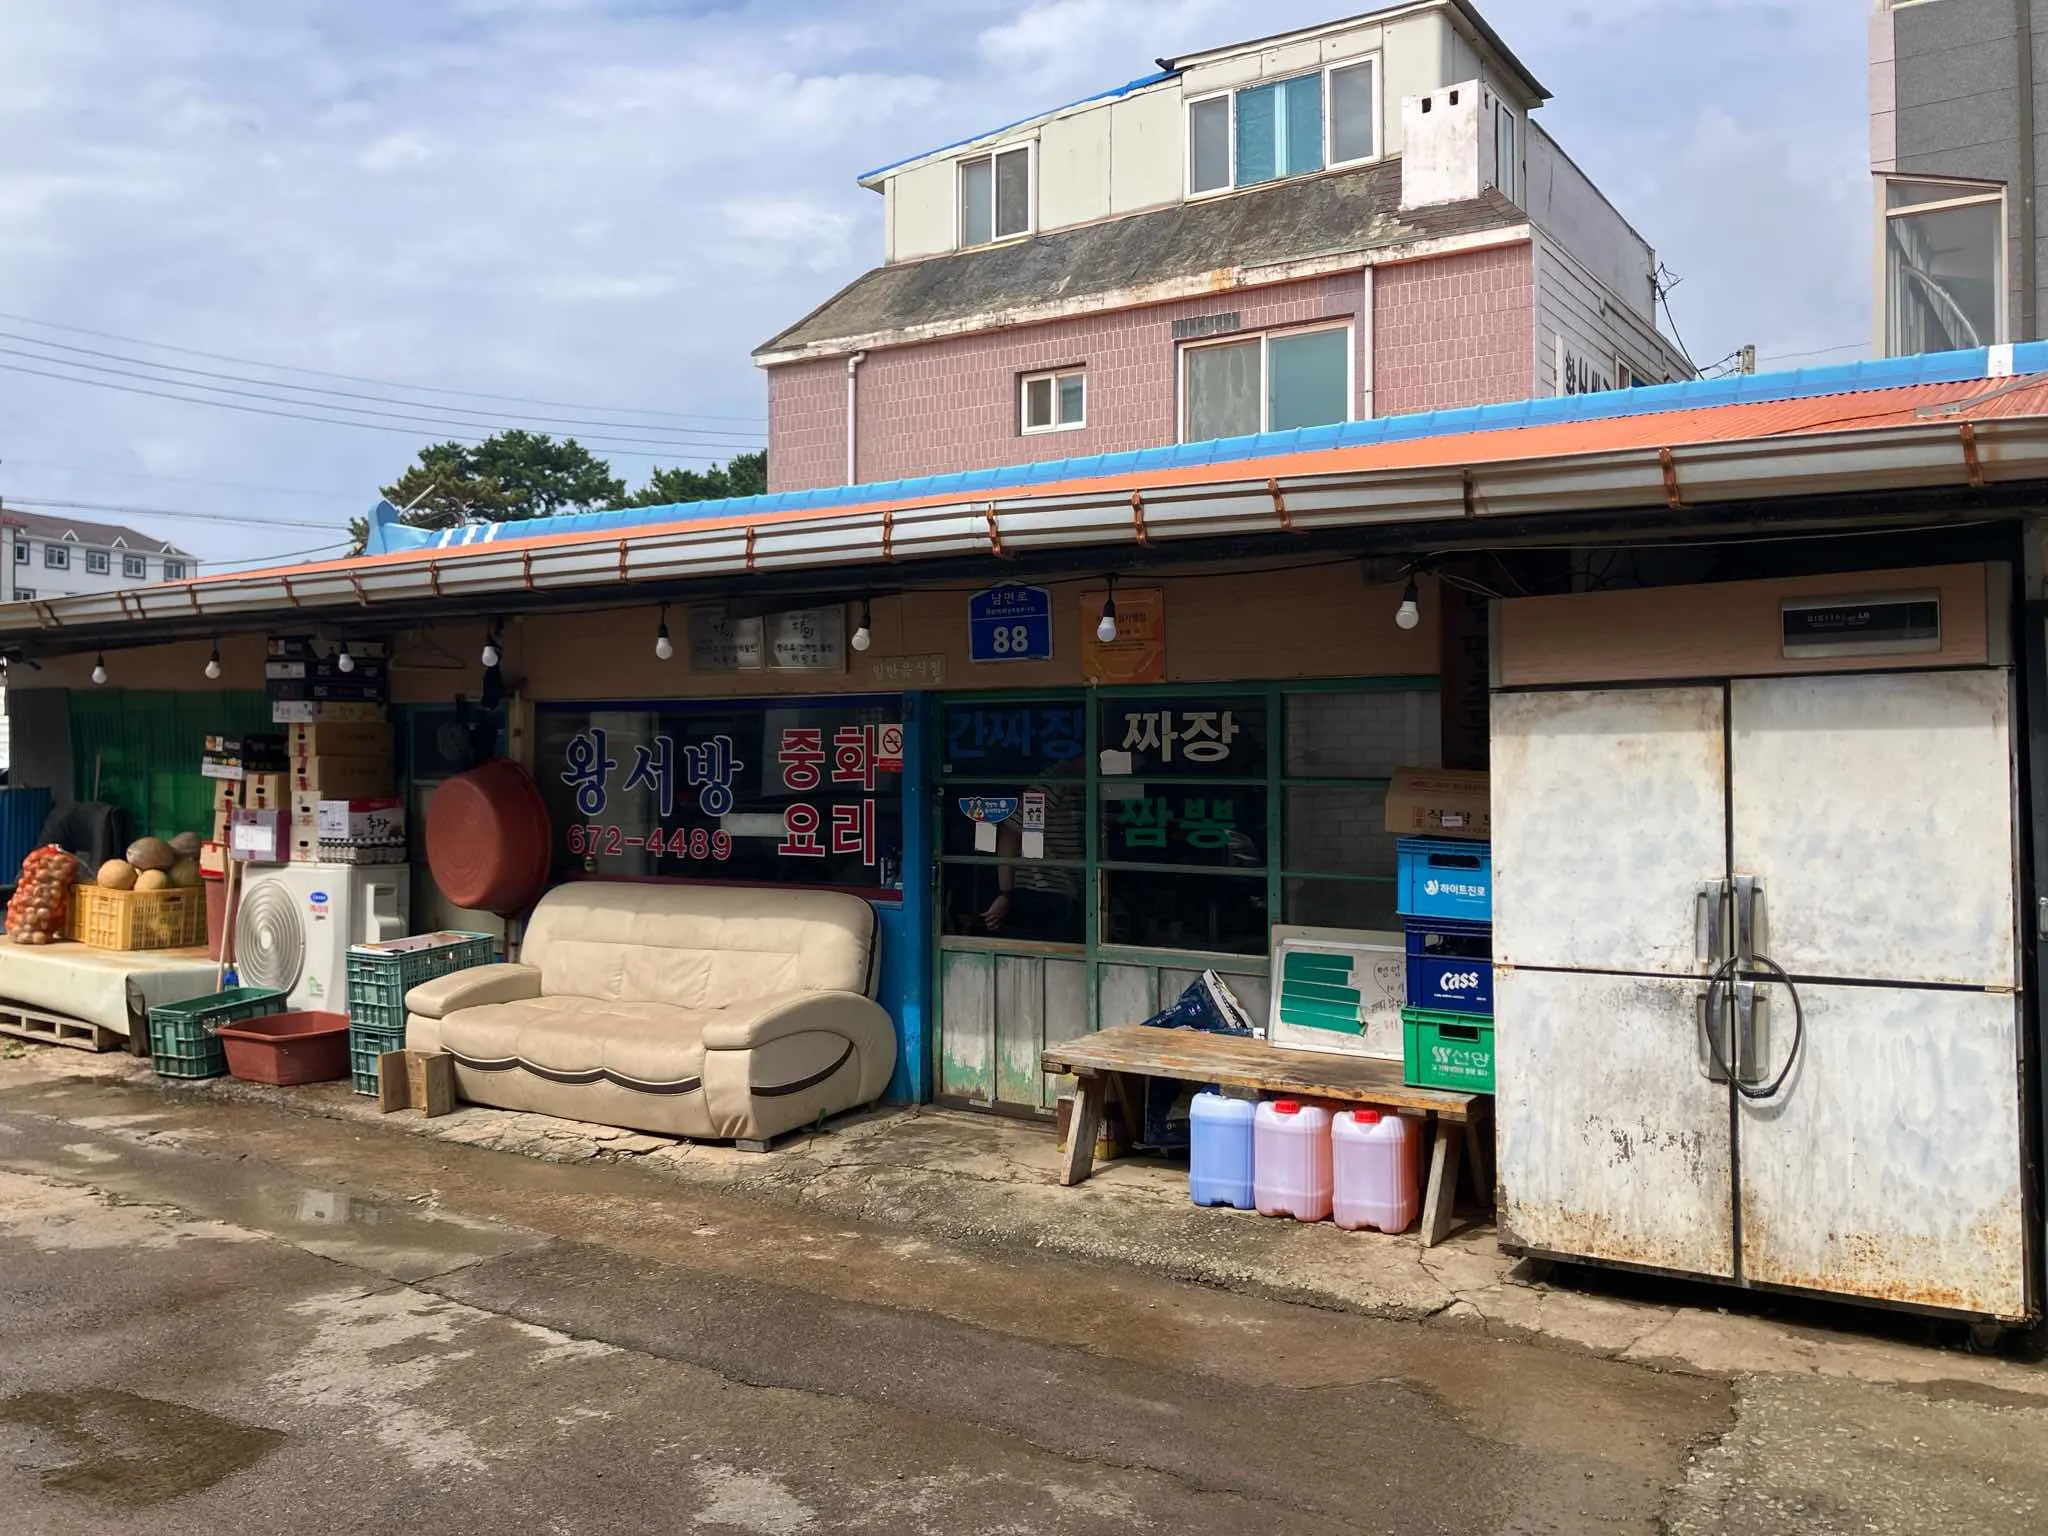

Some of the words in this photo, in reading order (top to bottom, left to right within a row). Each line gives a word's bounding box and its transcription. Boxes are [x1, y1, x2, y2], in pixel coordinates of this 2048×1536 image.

[991, 591, 1028, 605] 남면로
[992, 624, 1029, 654] 88
[947, 708, 1085, 759] 간짜장
[1121, 709, 1241, 763] 짜장
[560, 727, 745, 817] 왕서방
[778, 724, 879, 791] 중화
[565, 823, 733, 860] 672-4489
[777, 799, 876, 866] 요리
[1116, 795, 1238, 849] 짬뽕
[1440, 883, 1486, 897] 하이트진로
[1440, 971, 1479, 991] Cass
[1451, 1049, 1491, 1068] 선양
